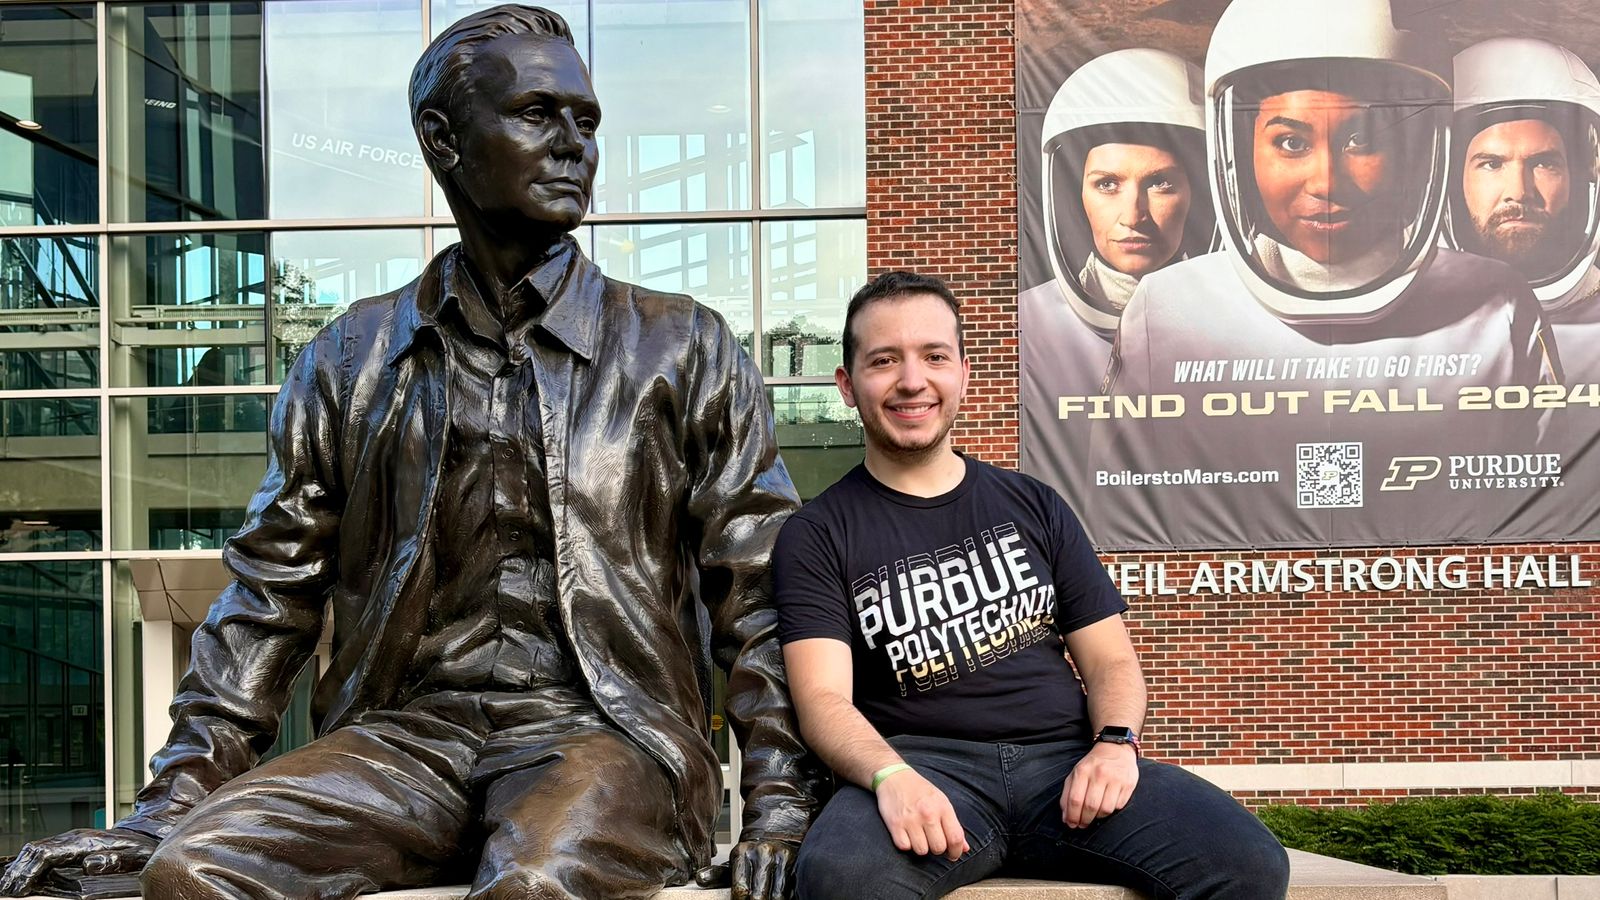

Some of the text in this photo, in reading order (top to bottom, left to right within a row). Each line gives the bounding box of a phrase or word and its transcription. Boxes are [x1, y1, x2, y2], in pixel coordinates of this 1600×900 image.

[291, 132, 423, 169] US AIR FORCE
[1174, 353, 1482, 383] WHAT WILL IT TAKE TO GO FIRST?
[1058, 383, 1600, 420] FIND OUT FALL 2024
[1096, 468, 1279, 486] BoilerstoMars.com
[1379, 456, 1442, 491] P
[1448, 453, 1562, 477] PURDUE
[1189, 556, 1468, 595] ARMSTRONG
[1484, 554, 1592, 589] HALL
[857, 548, 1039, 651] PURDUE
[885, 584, 1055, 672] POLYTECHNIC
